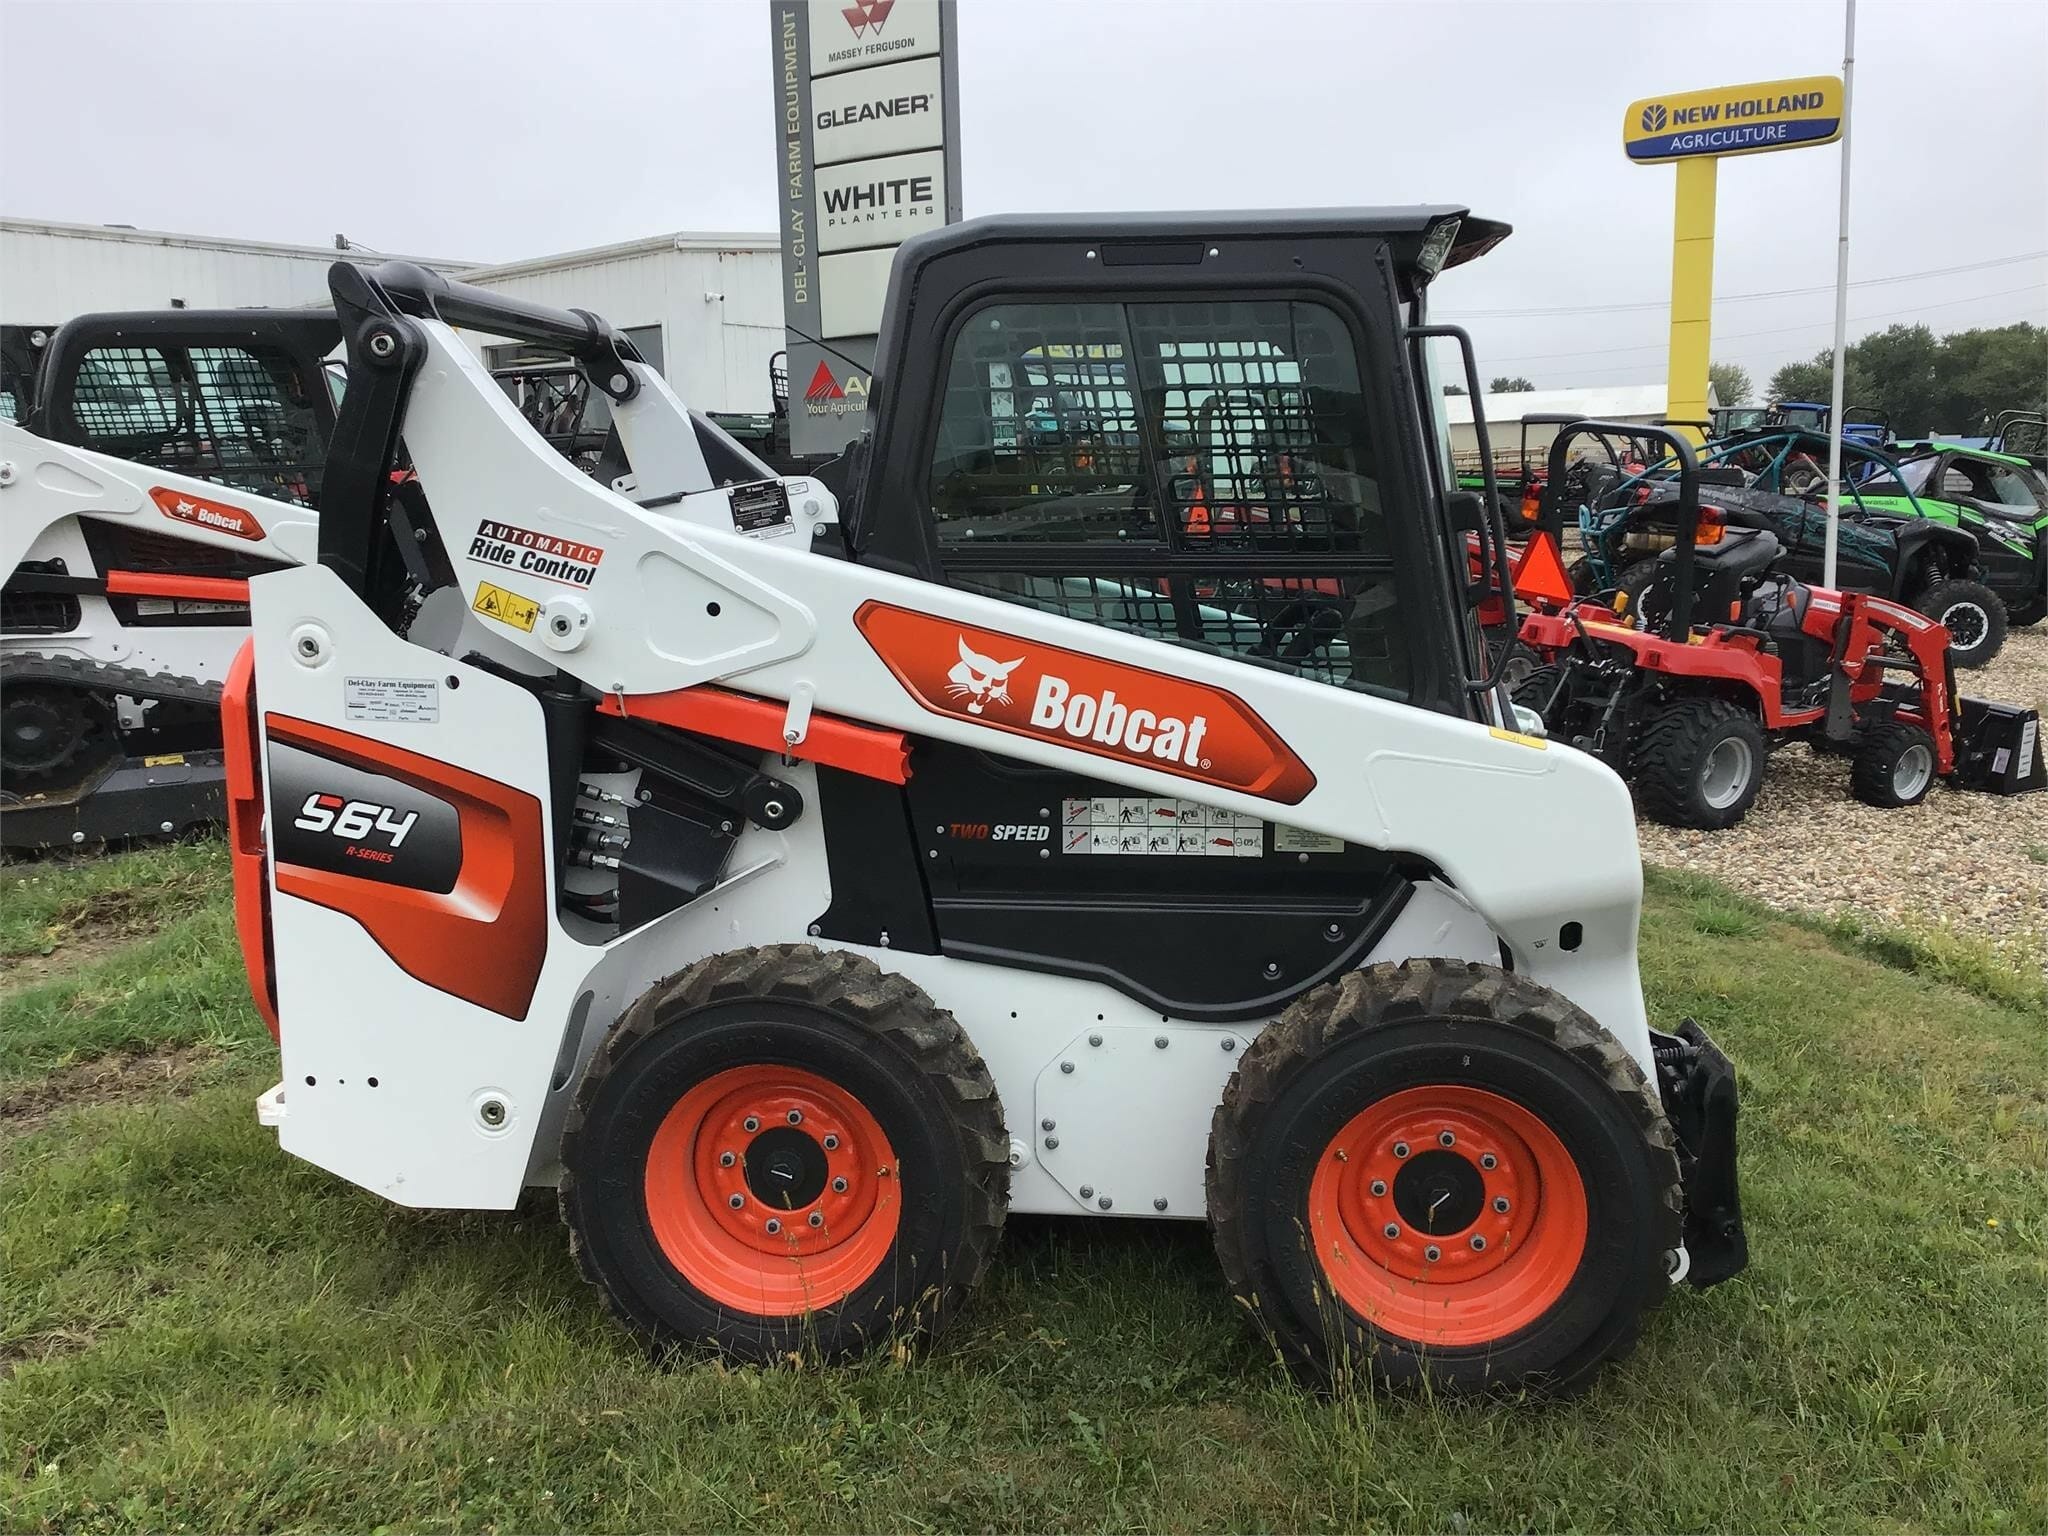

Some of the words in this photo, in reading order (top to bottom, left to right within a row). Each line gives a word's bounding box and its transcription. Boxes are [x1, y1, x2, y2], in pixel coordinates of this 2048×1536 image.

[828, 47, 863, 63] MASSEY
[865, 37, 915, 56] FERGUSON
[782, 10, 801, 135] EQUIPMENT
[816, 94, 929, 130] GLEANER
[1672, 103, 1720, 126] NEW
[1724, 91, 1824, 120] HOLLAND
[1669, 124, 1787, 151] AGRICULTURE
[789, 140, 803, 200] FARM
[823, 176, 933, 214] WHITE
[828, 205, 933, 227] PLANTERS
[792, 208, 807, 304] DEL-CLAY
[806, 403, 828, 415] Your
[197, 507, 243, 532] Bobcat
[482, 523, 598, 562] AUTOMATIC
[468, 537, 516, 565] Ride
[519, 550, 597, 586] Control
[378, 680, 397, 688] Farm
[398, 681, 436, 690] Equipment
[1029, 674, 1207, 768] Bobcat
[294, 793, 419, 848] S64
[950, 823, 989, 839] TWO
[992, 824, 1050, 841] SPEED
[345, 846, 395, 863] R-SERIES
